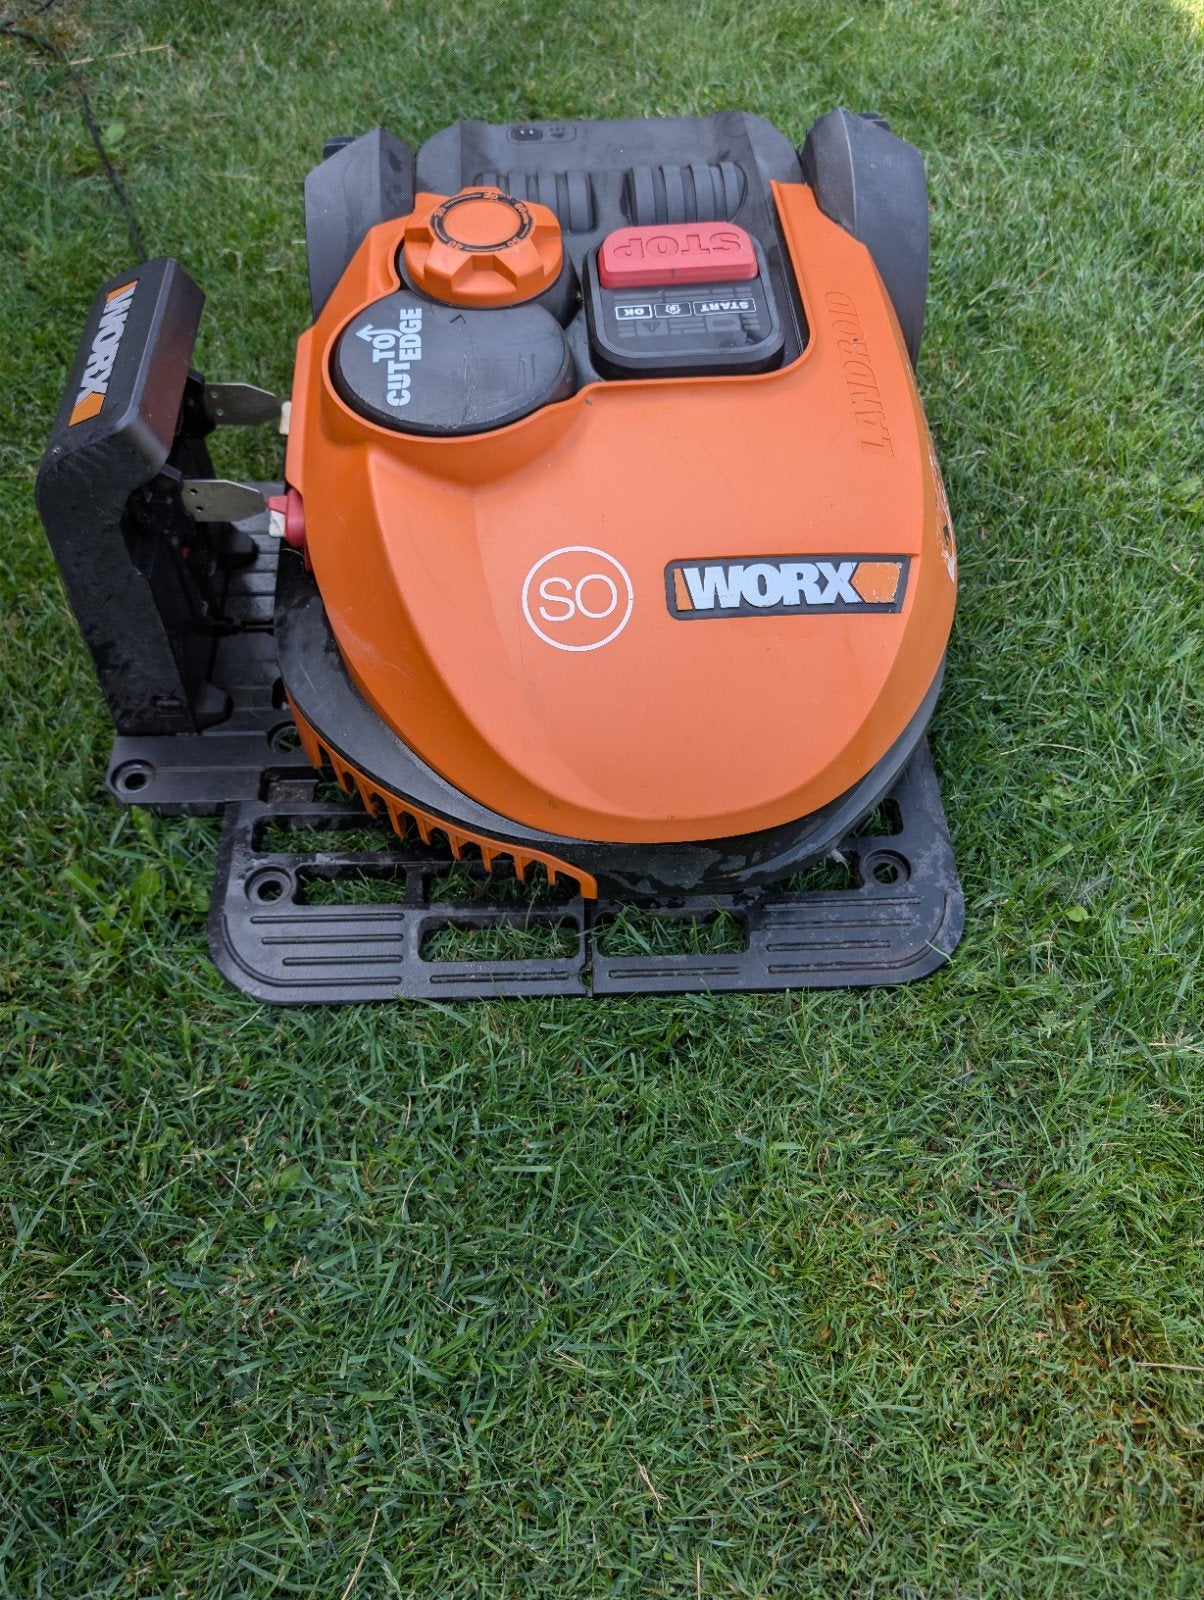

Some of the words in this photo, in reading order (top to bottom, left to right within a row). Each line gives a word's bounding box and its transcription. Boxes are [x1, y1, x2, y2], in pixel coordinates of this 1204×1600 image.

[614, 231, 742, 259] STOP
[624, 308, 645, 316] OK
[701, 300, 749, 312] START
[75, 285, 137, 406] WORX
[372, 333, 396, 363] TO
[399, 308, 423, 361] EDGE
[387, 361, 411, 406] CUT
[825, 291, 895, 458] LANDROID
[538, 573, 618, 622] SO
[682, 562, 861, 610] WORX
